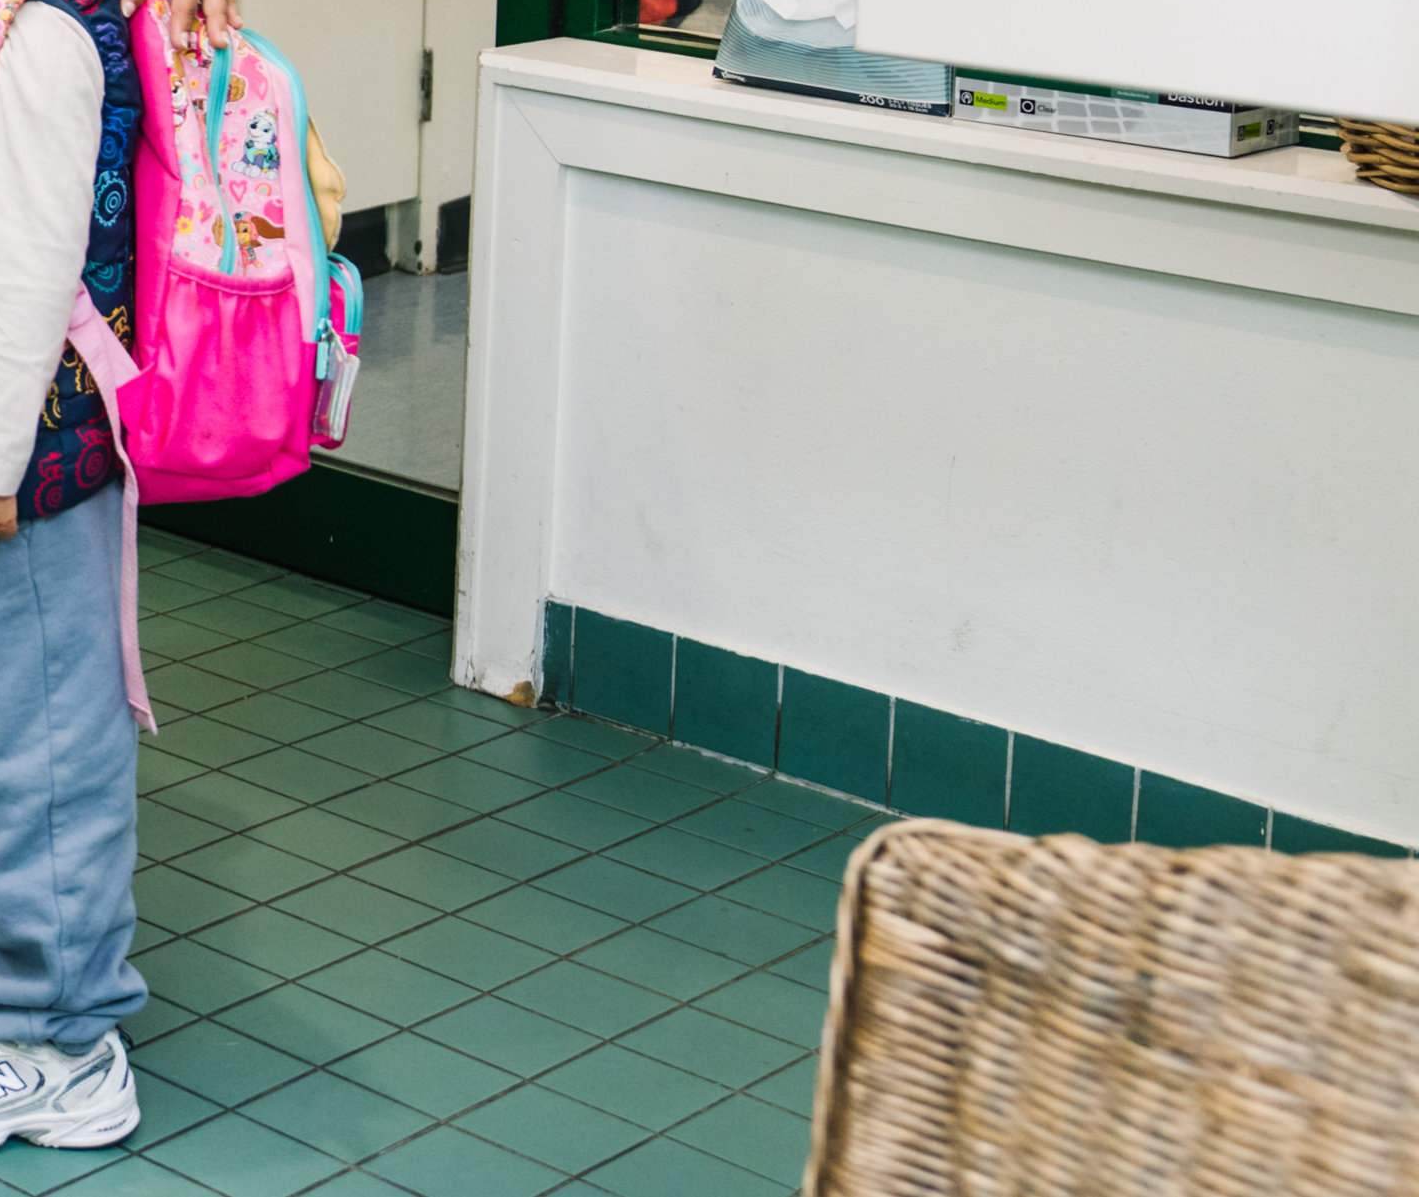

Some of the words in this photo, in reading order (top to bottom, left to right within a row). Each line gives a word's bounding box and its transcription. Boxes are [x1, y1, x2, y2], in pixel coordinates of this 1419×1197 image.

[859, 94, 885, 106] 200
[975, 95, 1006, 108] Medium
[1037, 103, 1057, 114] Clear
